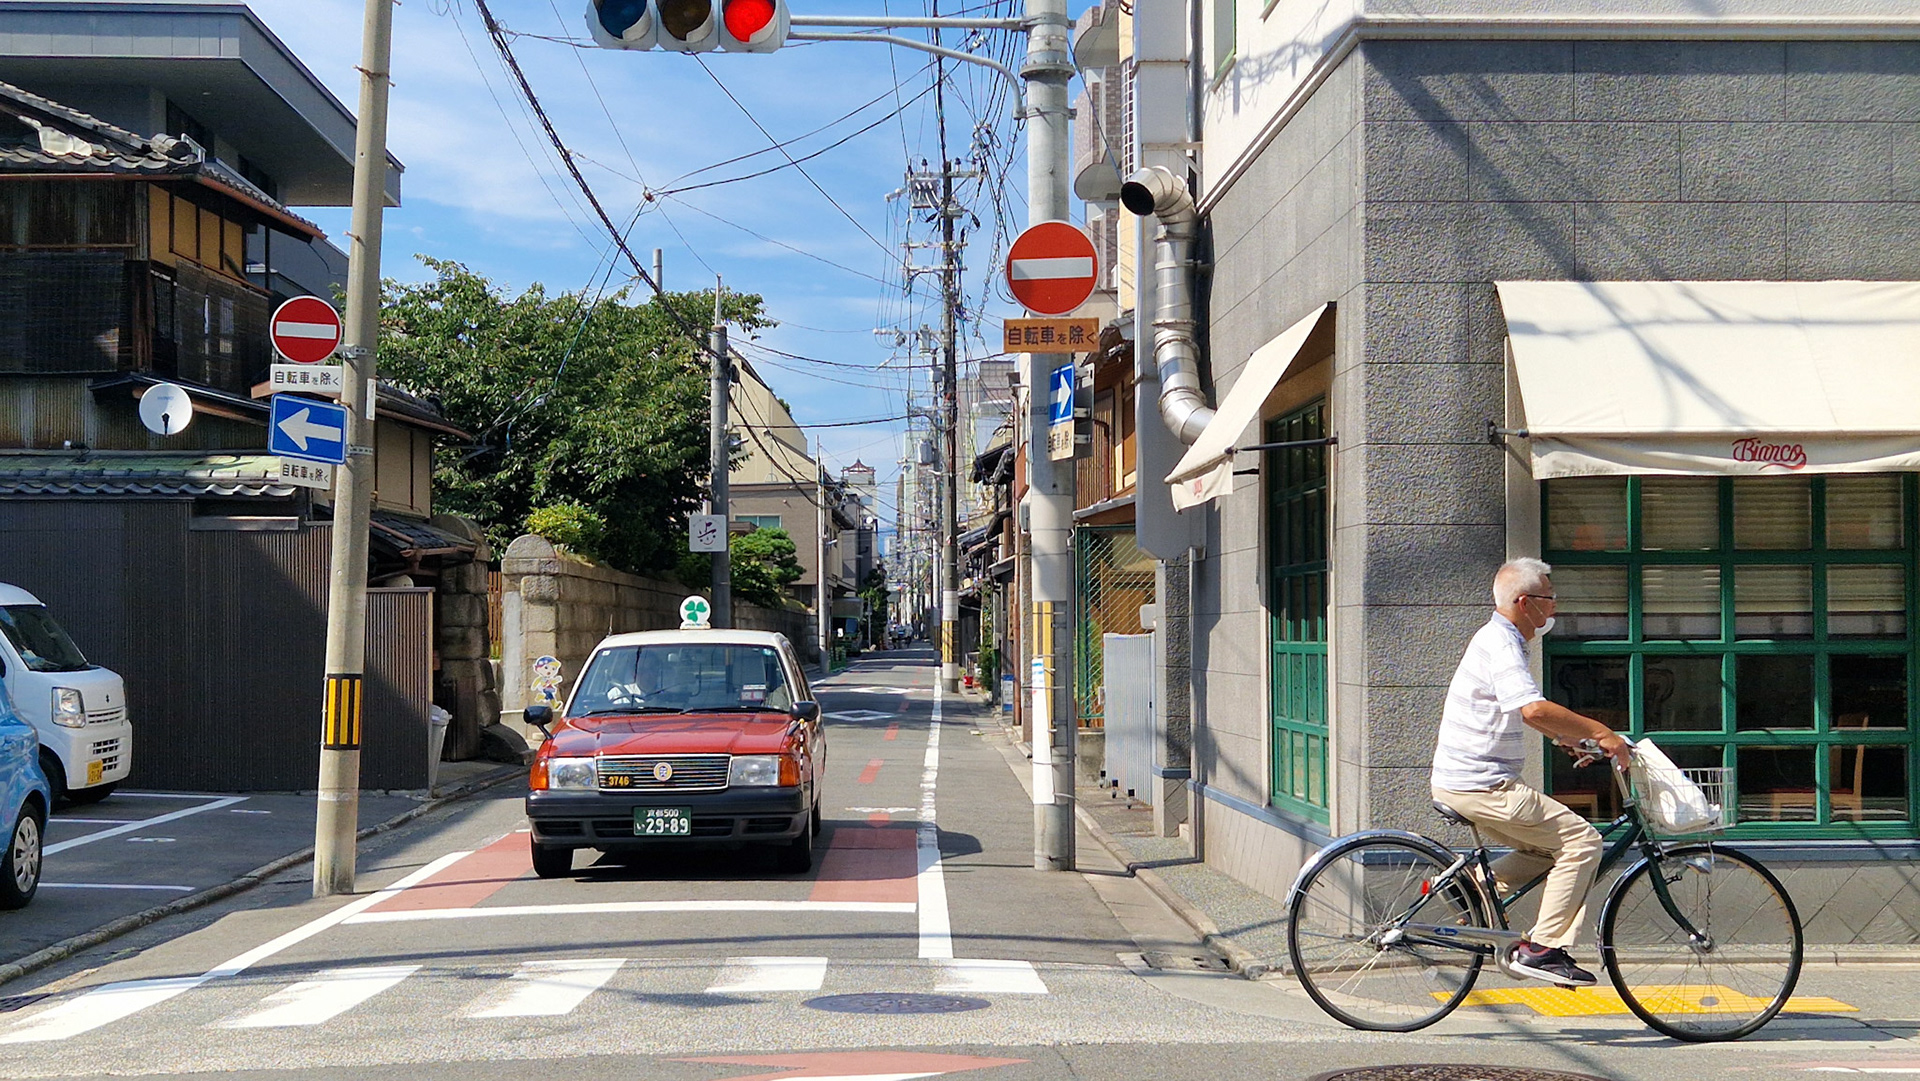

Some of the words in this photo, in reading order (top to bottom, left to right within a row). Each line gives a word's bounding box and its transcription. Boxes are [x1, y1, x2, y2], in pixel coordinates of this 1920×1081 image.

[1008, 325, 1095, 345] 自転車を除く
[274, 371, 339, 386] 自転車を除く
[1732, 437, 1807, 471] Bianco
[282, 463, 329, 483] 自転車を除く
[608, 776, 630, 786] 3746
